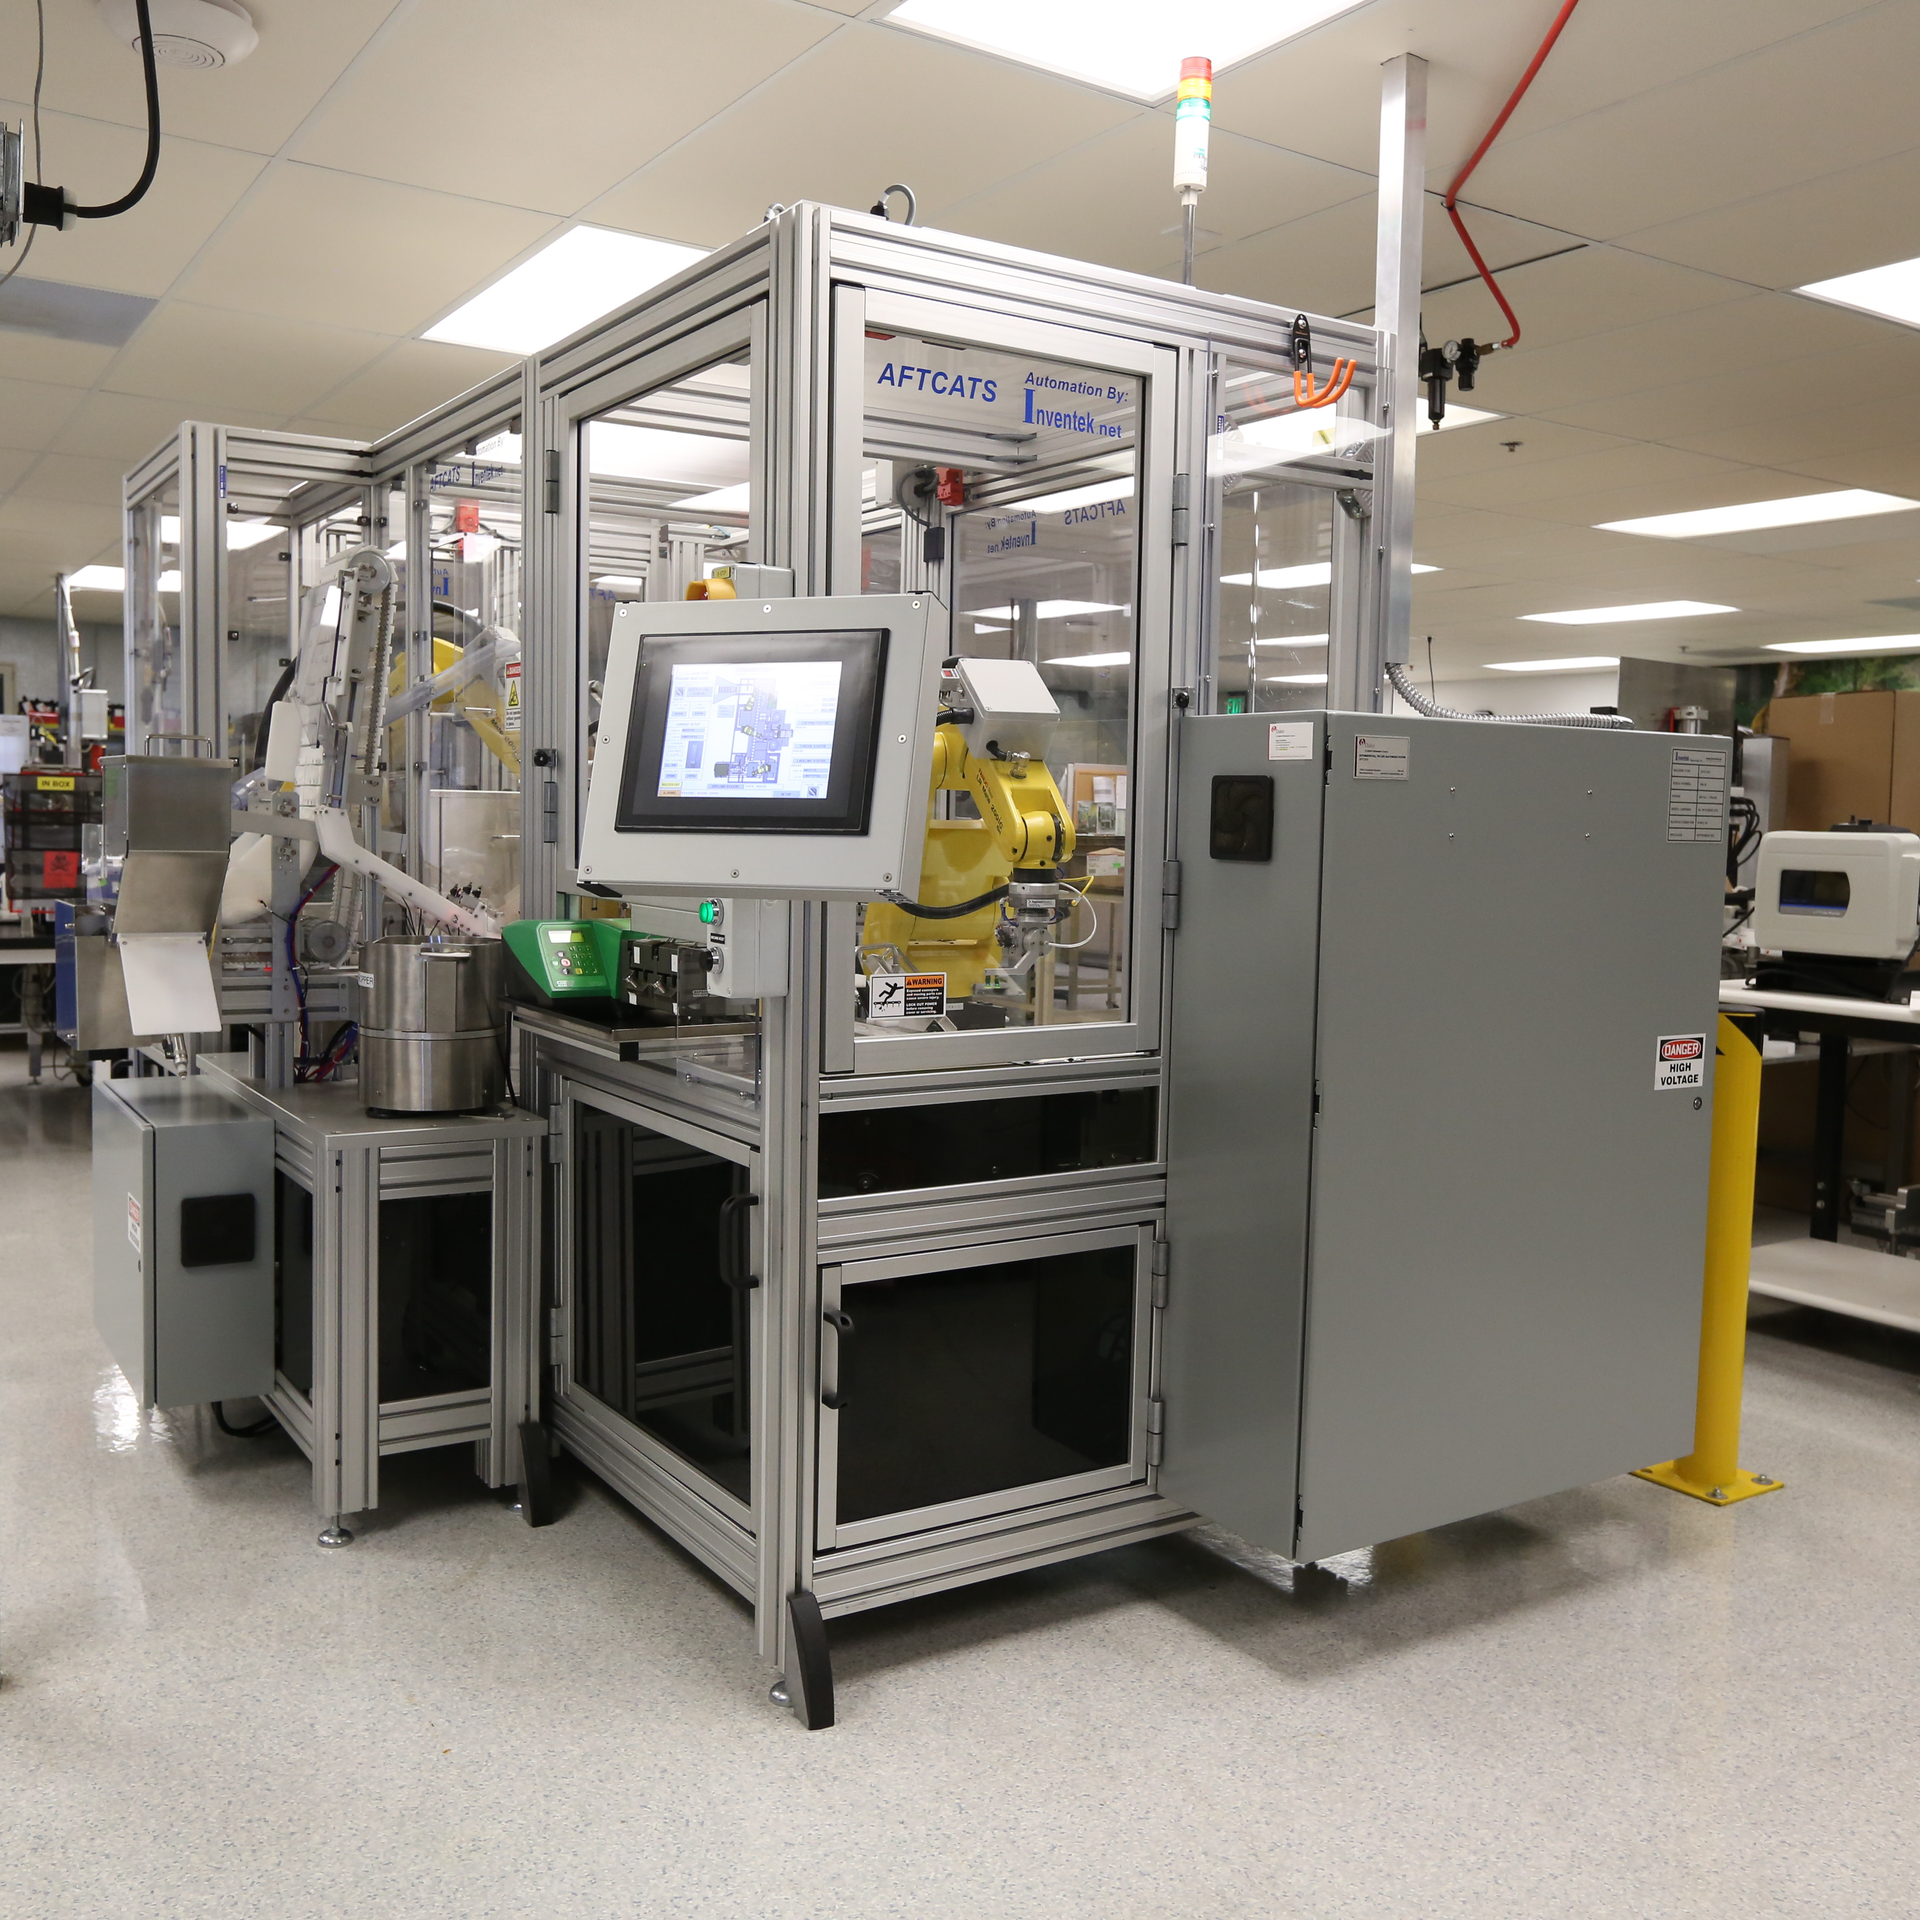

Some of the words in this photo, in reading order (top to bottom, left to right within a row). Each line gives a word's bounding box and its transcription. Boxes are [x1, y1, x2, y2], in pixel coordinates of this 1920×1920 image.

[878, 363, 998, 403] AFTCATS
[1024, 371, 1103, 398] Automation
[1106, 386, 1129, 404] By:
[52, 780, 71, 788] BOX
[912, 978, 943, 986] WARNING
[1664, 1043, 1700, 1056] DANGER
[1669, 1062, 1692, 1073] HIGH
[1660, 1074, 1699, 1086] VOLTAGE
